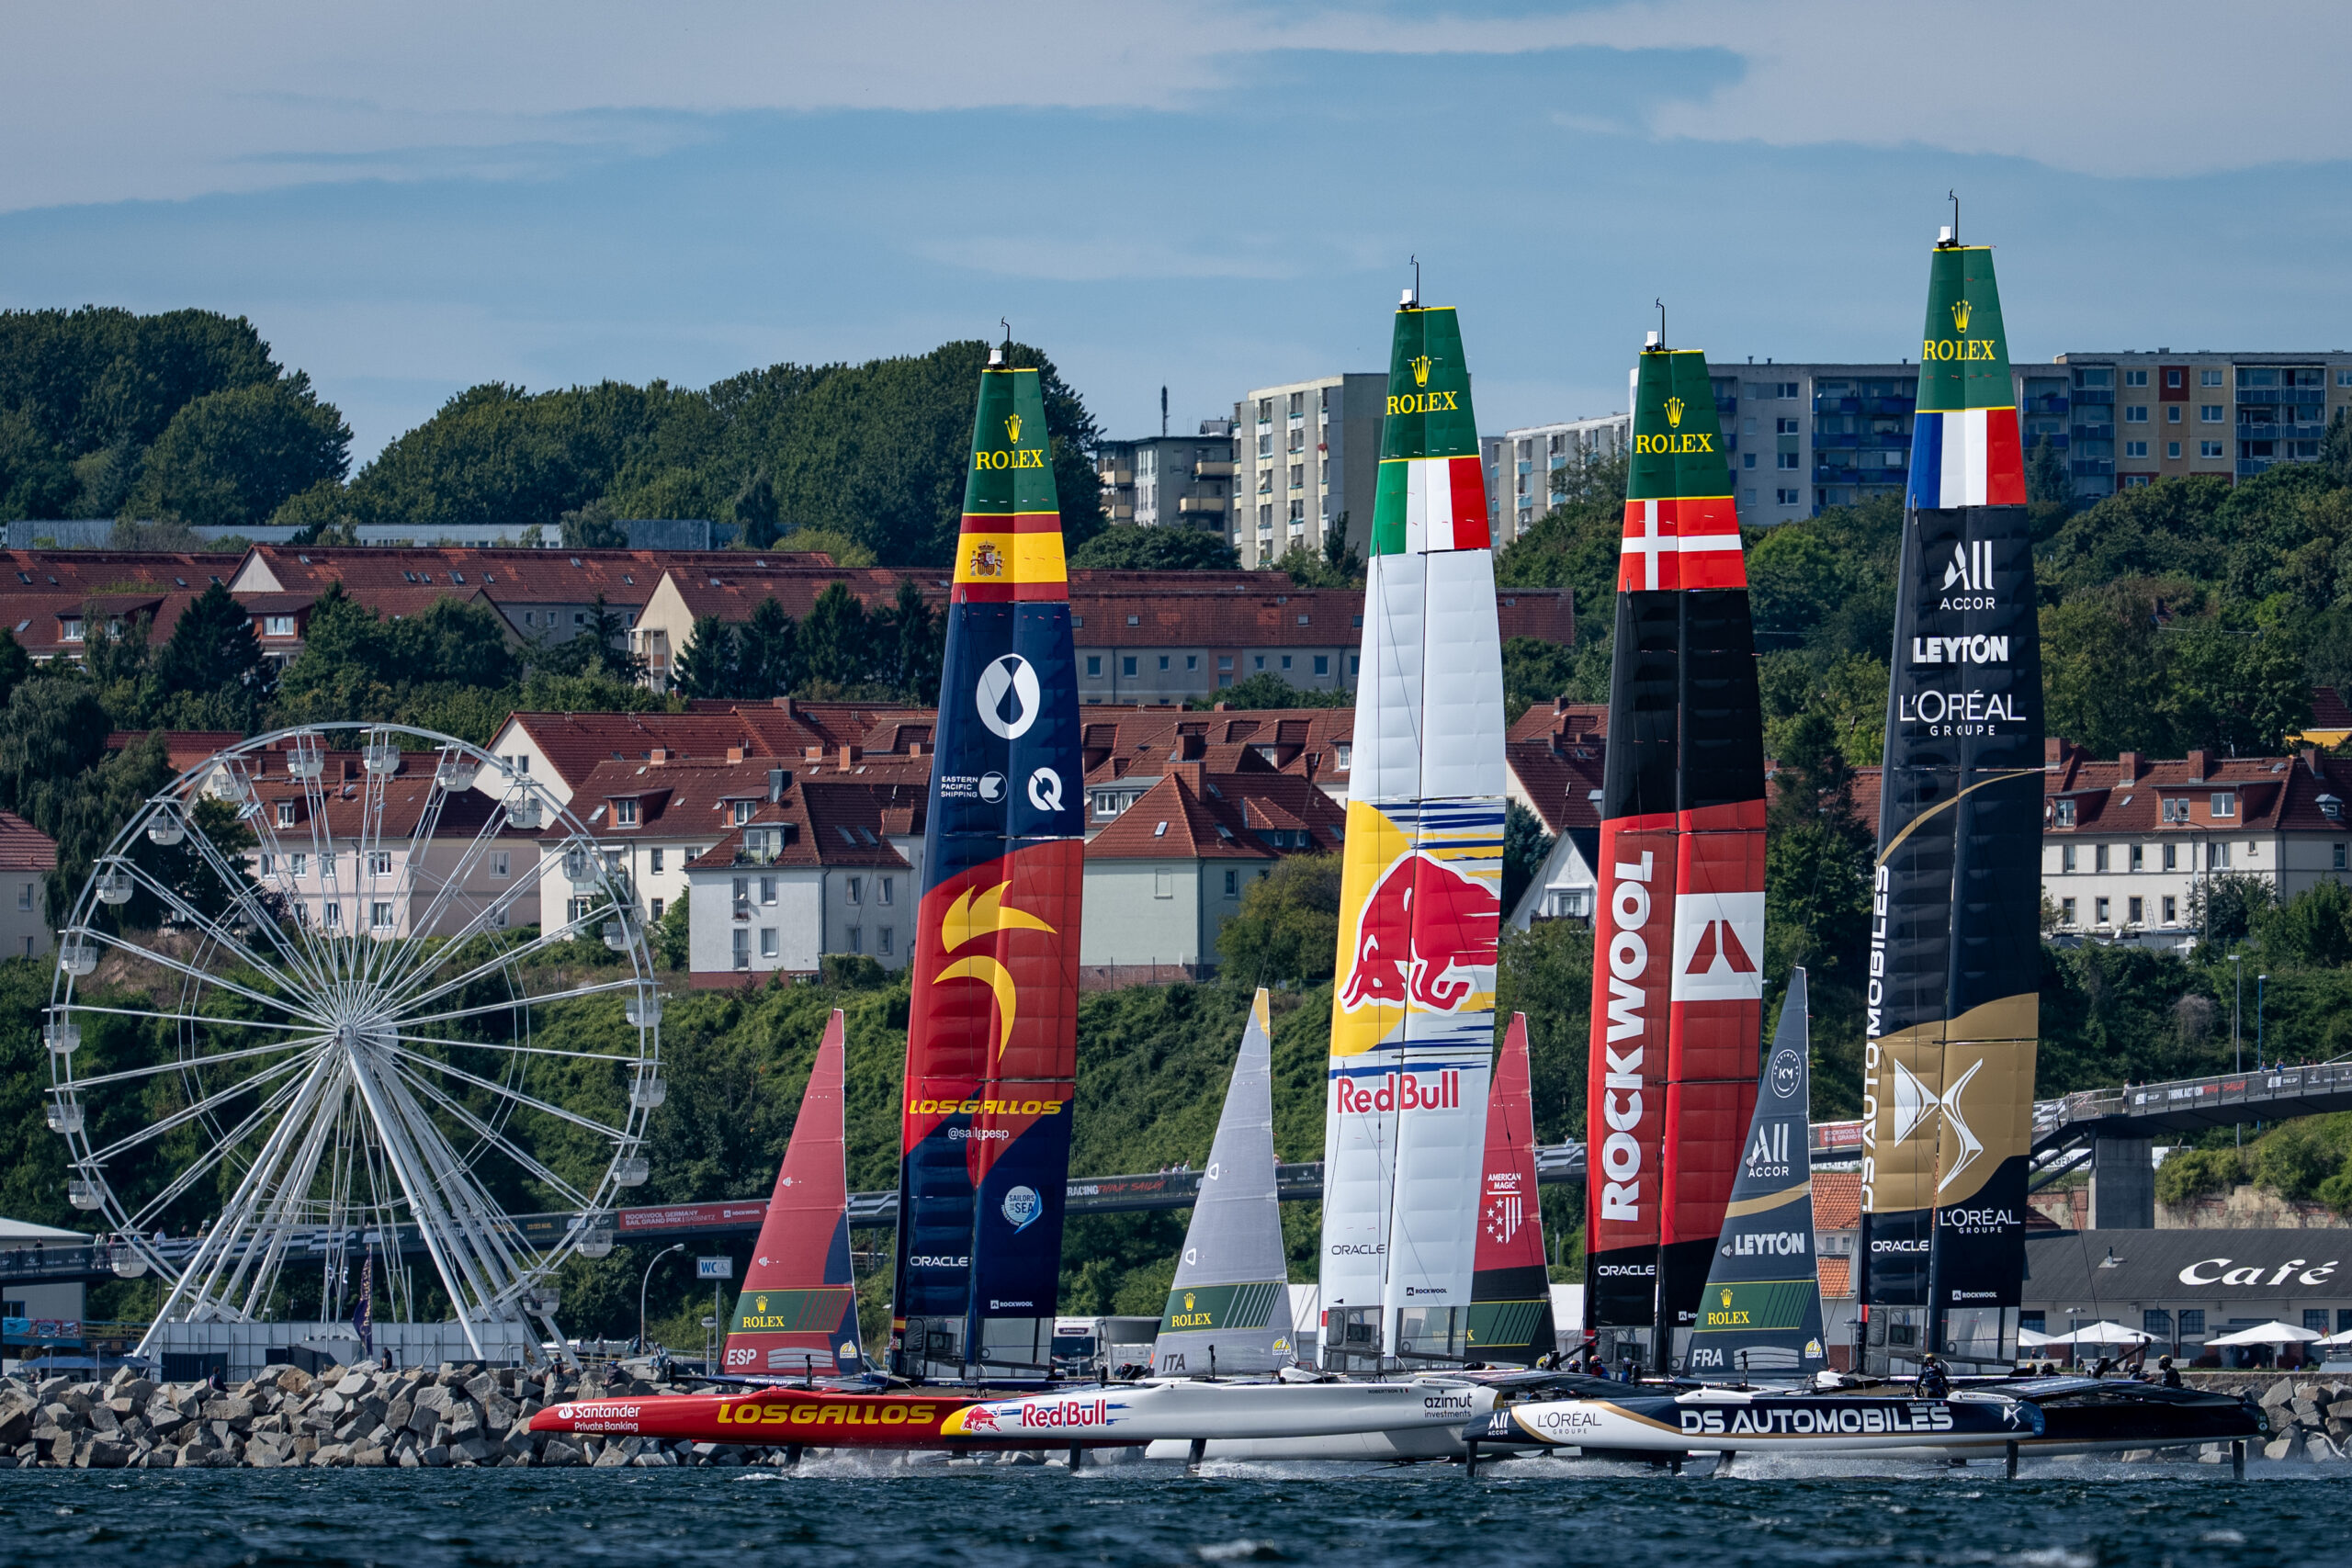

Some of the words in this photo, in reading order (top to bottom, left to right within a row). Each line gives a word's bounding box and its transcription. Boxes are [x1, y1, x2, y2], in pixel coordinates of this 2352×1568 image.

[1923, 339, 1996, 361] ROLEX
[1385, 391, 1458, 415] ROLEX
[1635, 434, 1714, 454] ROLEX
[975, 449, 1044, 470] ROLEX
[1939, 597, 1996, 611] ACCOR
[1913, 634, 2008, 664] LEYTON
[1899, 689, 2027, 724] L'ORÉAL
[1930, 725, 1996, 737] GROUPE
[1861, 864, 1890, 1151] AUTOMOBILES
[1601, 850, 1654, 1222] ROCKWOOL
[1337, 1073, 1395, 1114] Red
[1400, 1070, 1459, 1111] Bull
[909, 1100, 1064, 1114] LOSGALLOS
[1487, 1172, 1521, 1181] AMERICAN
[1748, 1167, 1790, 1178] ACCOR
[1067, 1184, 1099, 1197] RACING
[1493, 1181, 1516, 1190] MAGIC
[1009, 1194, 1035, 1202] SAILORS
[664, 1210, 698, 1218] GERMANY
[1014, 1202, 1035, 1213] SEA
[1939, 1207, 2021, 1227] L'ORÉAL
[1330, 1244, 1385, 1256] ORACLE
[1735, 1232, 1805, 1257] LEYTON
[1871, 1239, 1929, 1252] ORACLE
[701, 1261, 717, 1273] WC
[910, 1256, 968, 1267] ORACLE
[1598, 1264, 1656, 1276] ORACLE
[2178, 1258, 2340, 1286] Café
[742, 1315, 785, 1328] ROLEX
[1171, 1313, 1212, 1327] ROLEX
[1708, 1311, 1750, 1325] ROLEX
[727, 1348, 757, 1366] ESP
[1162, 1353, 1186, 1371] ITA
[1691, 1348, 1724, 1368] FRA
[1424, 1393, 1472, 1408] azimut
[575, 1406, 640, 1419] Santander
[717, 1404, 936, 1425] LOSGALLOS
[1023, 1400, 1063, 1427] Red
[1067, 1399, 1106, 1426] Bull
[1424, 1409, 1472, 1418] investments
[1537, 1411, 1602, 1427] L'ORÉAL
[574, 1421, 604, 1431] Private
[604, 1421, 639, 1432] Banking
[1680, 1409, 1725, 1434] DS
[1730, 1406, 1953, 1434] AUTOMOBILES
